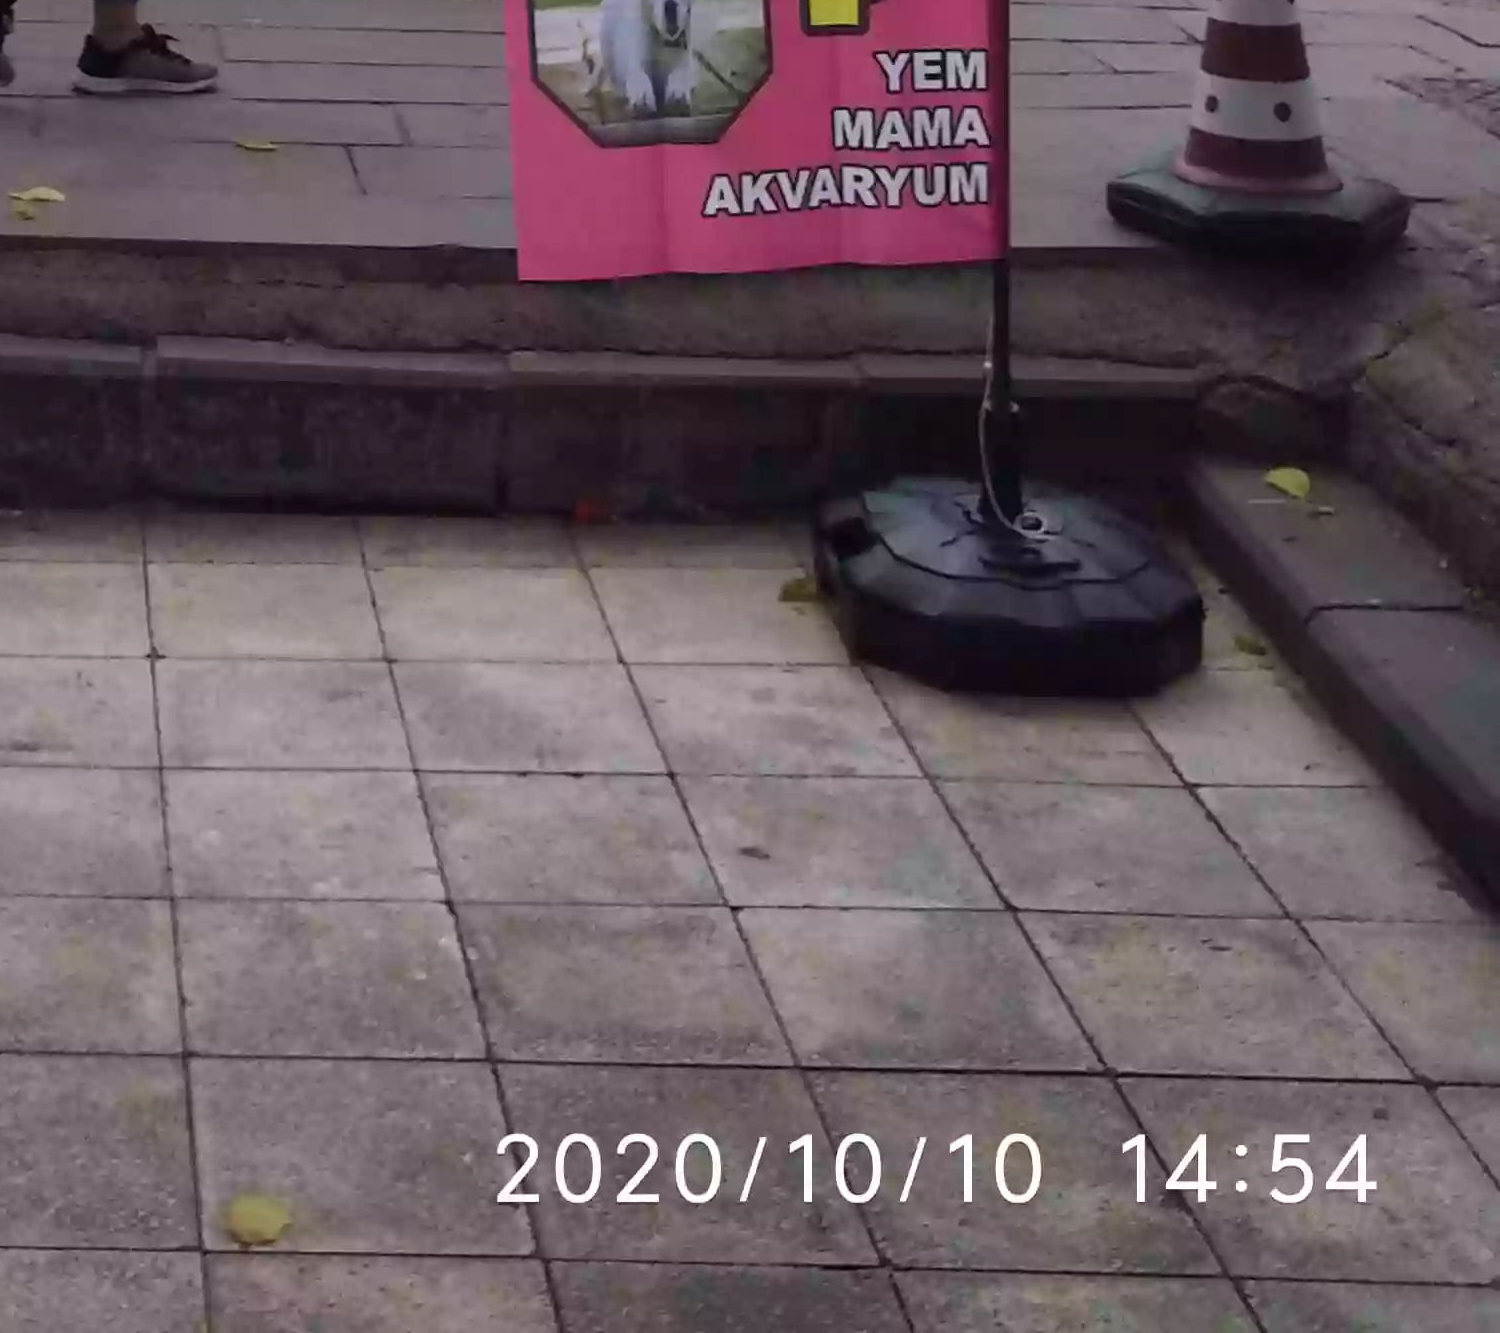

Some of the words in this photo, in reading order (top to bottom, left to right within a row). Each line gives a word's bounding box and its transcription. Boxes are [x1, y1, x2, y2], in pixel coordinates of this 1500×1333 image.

[875, 49, 990, 95] YEM
[831, 105, 992, 151] MAMA
[702, 162, 990, 218] AKVARYUM
